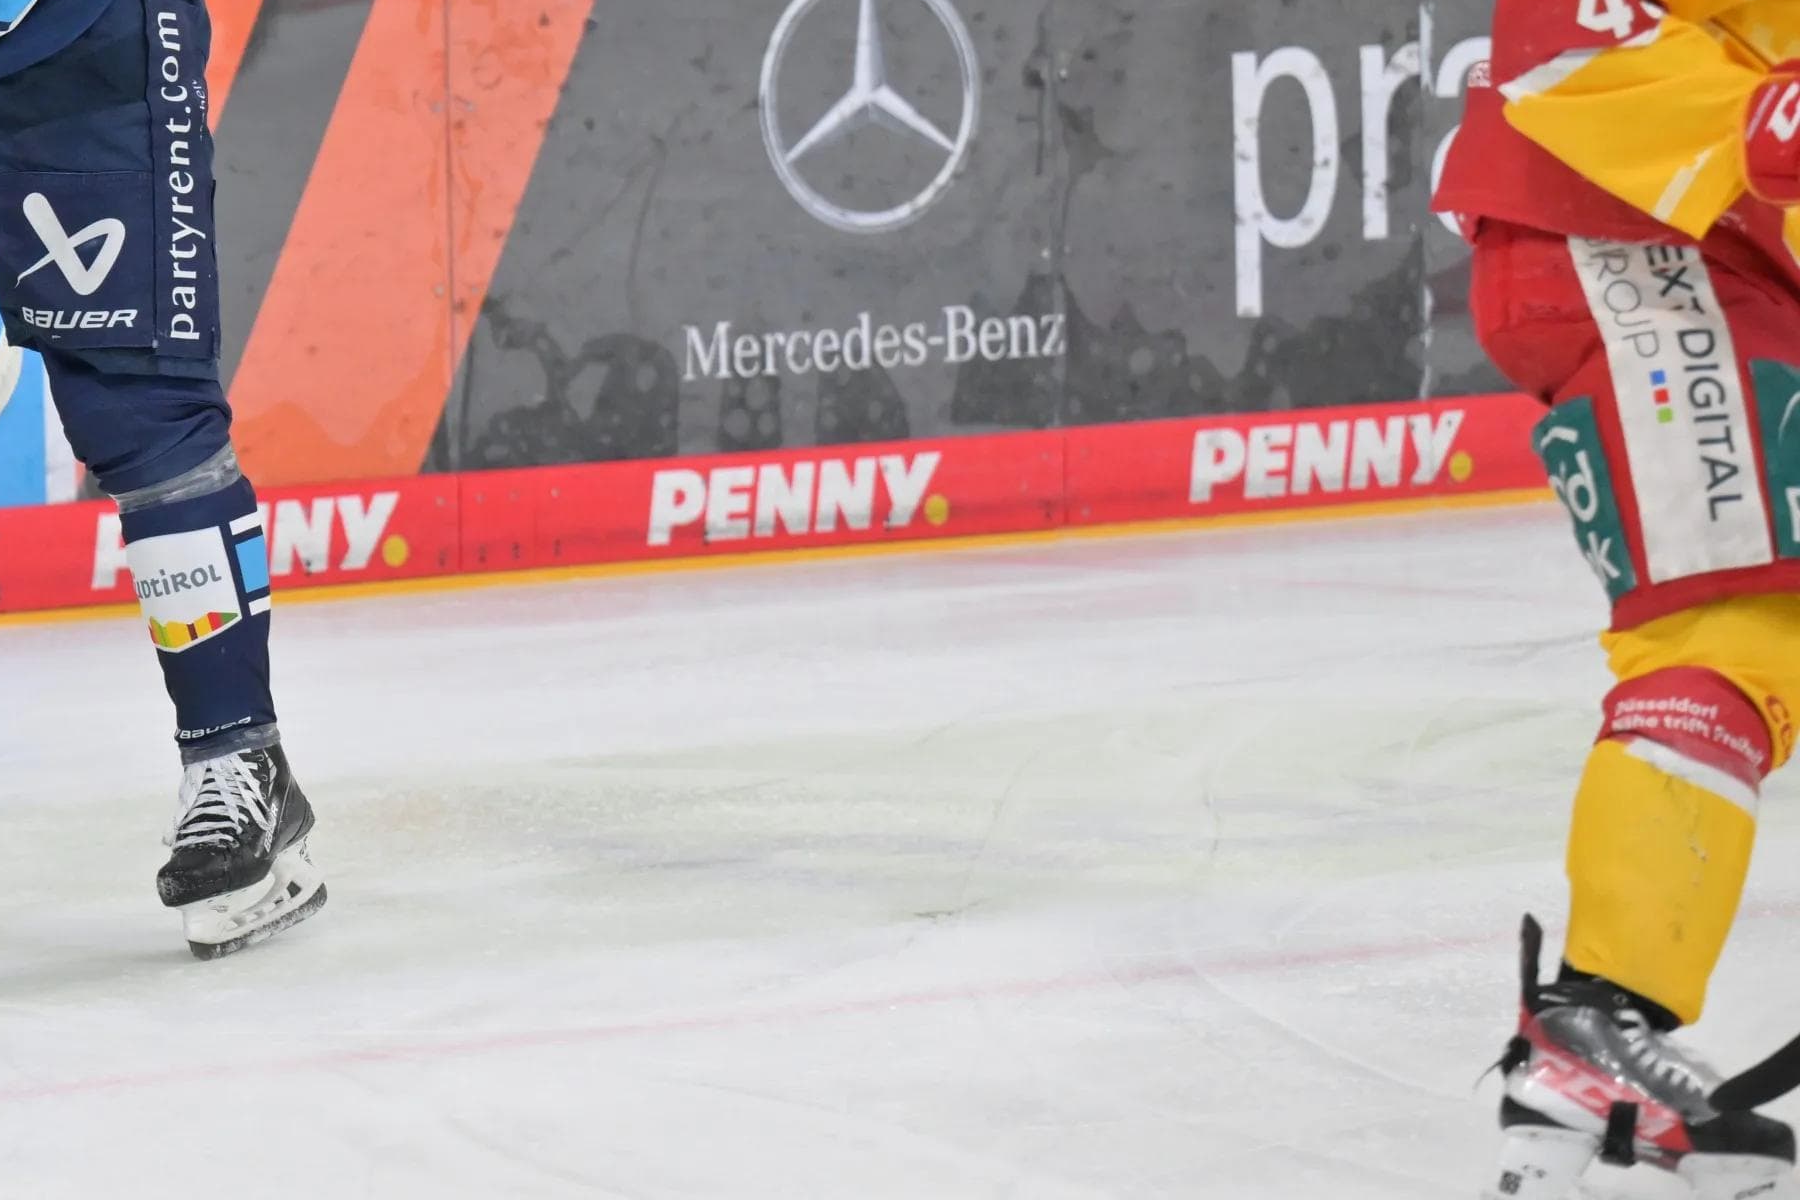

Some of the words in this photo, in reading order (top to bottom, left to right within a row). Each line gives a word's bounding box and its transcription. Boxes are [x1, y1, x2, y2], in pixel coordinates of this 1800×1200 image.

[157, 10, 207, 341] partyrent.com
[21, 306, 138, 330] BAUER
[682, 305, 1068, 382] Mercedes-Benz
[1676, 327, 1743, 523] DIGITAL
